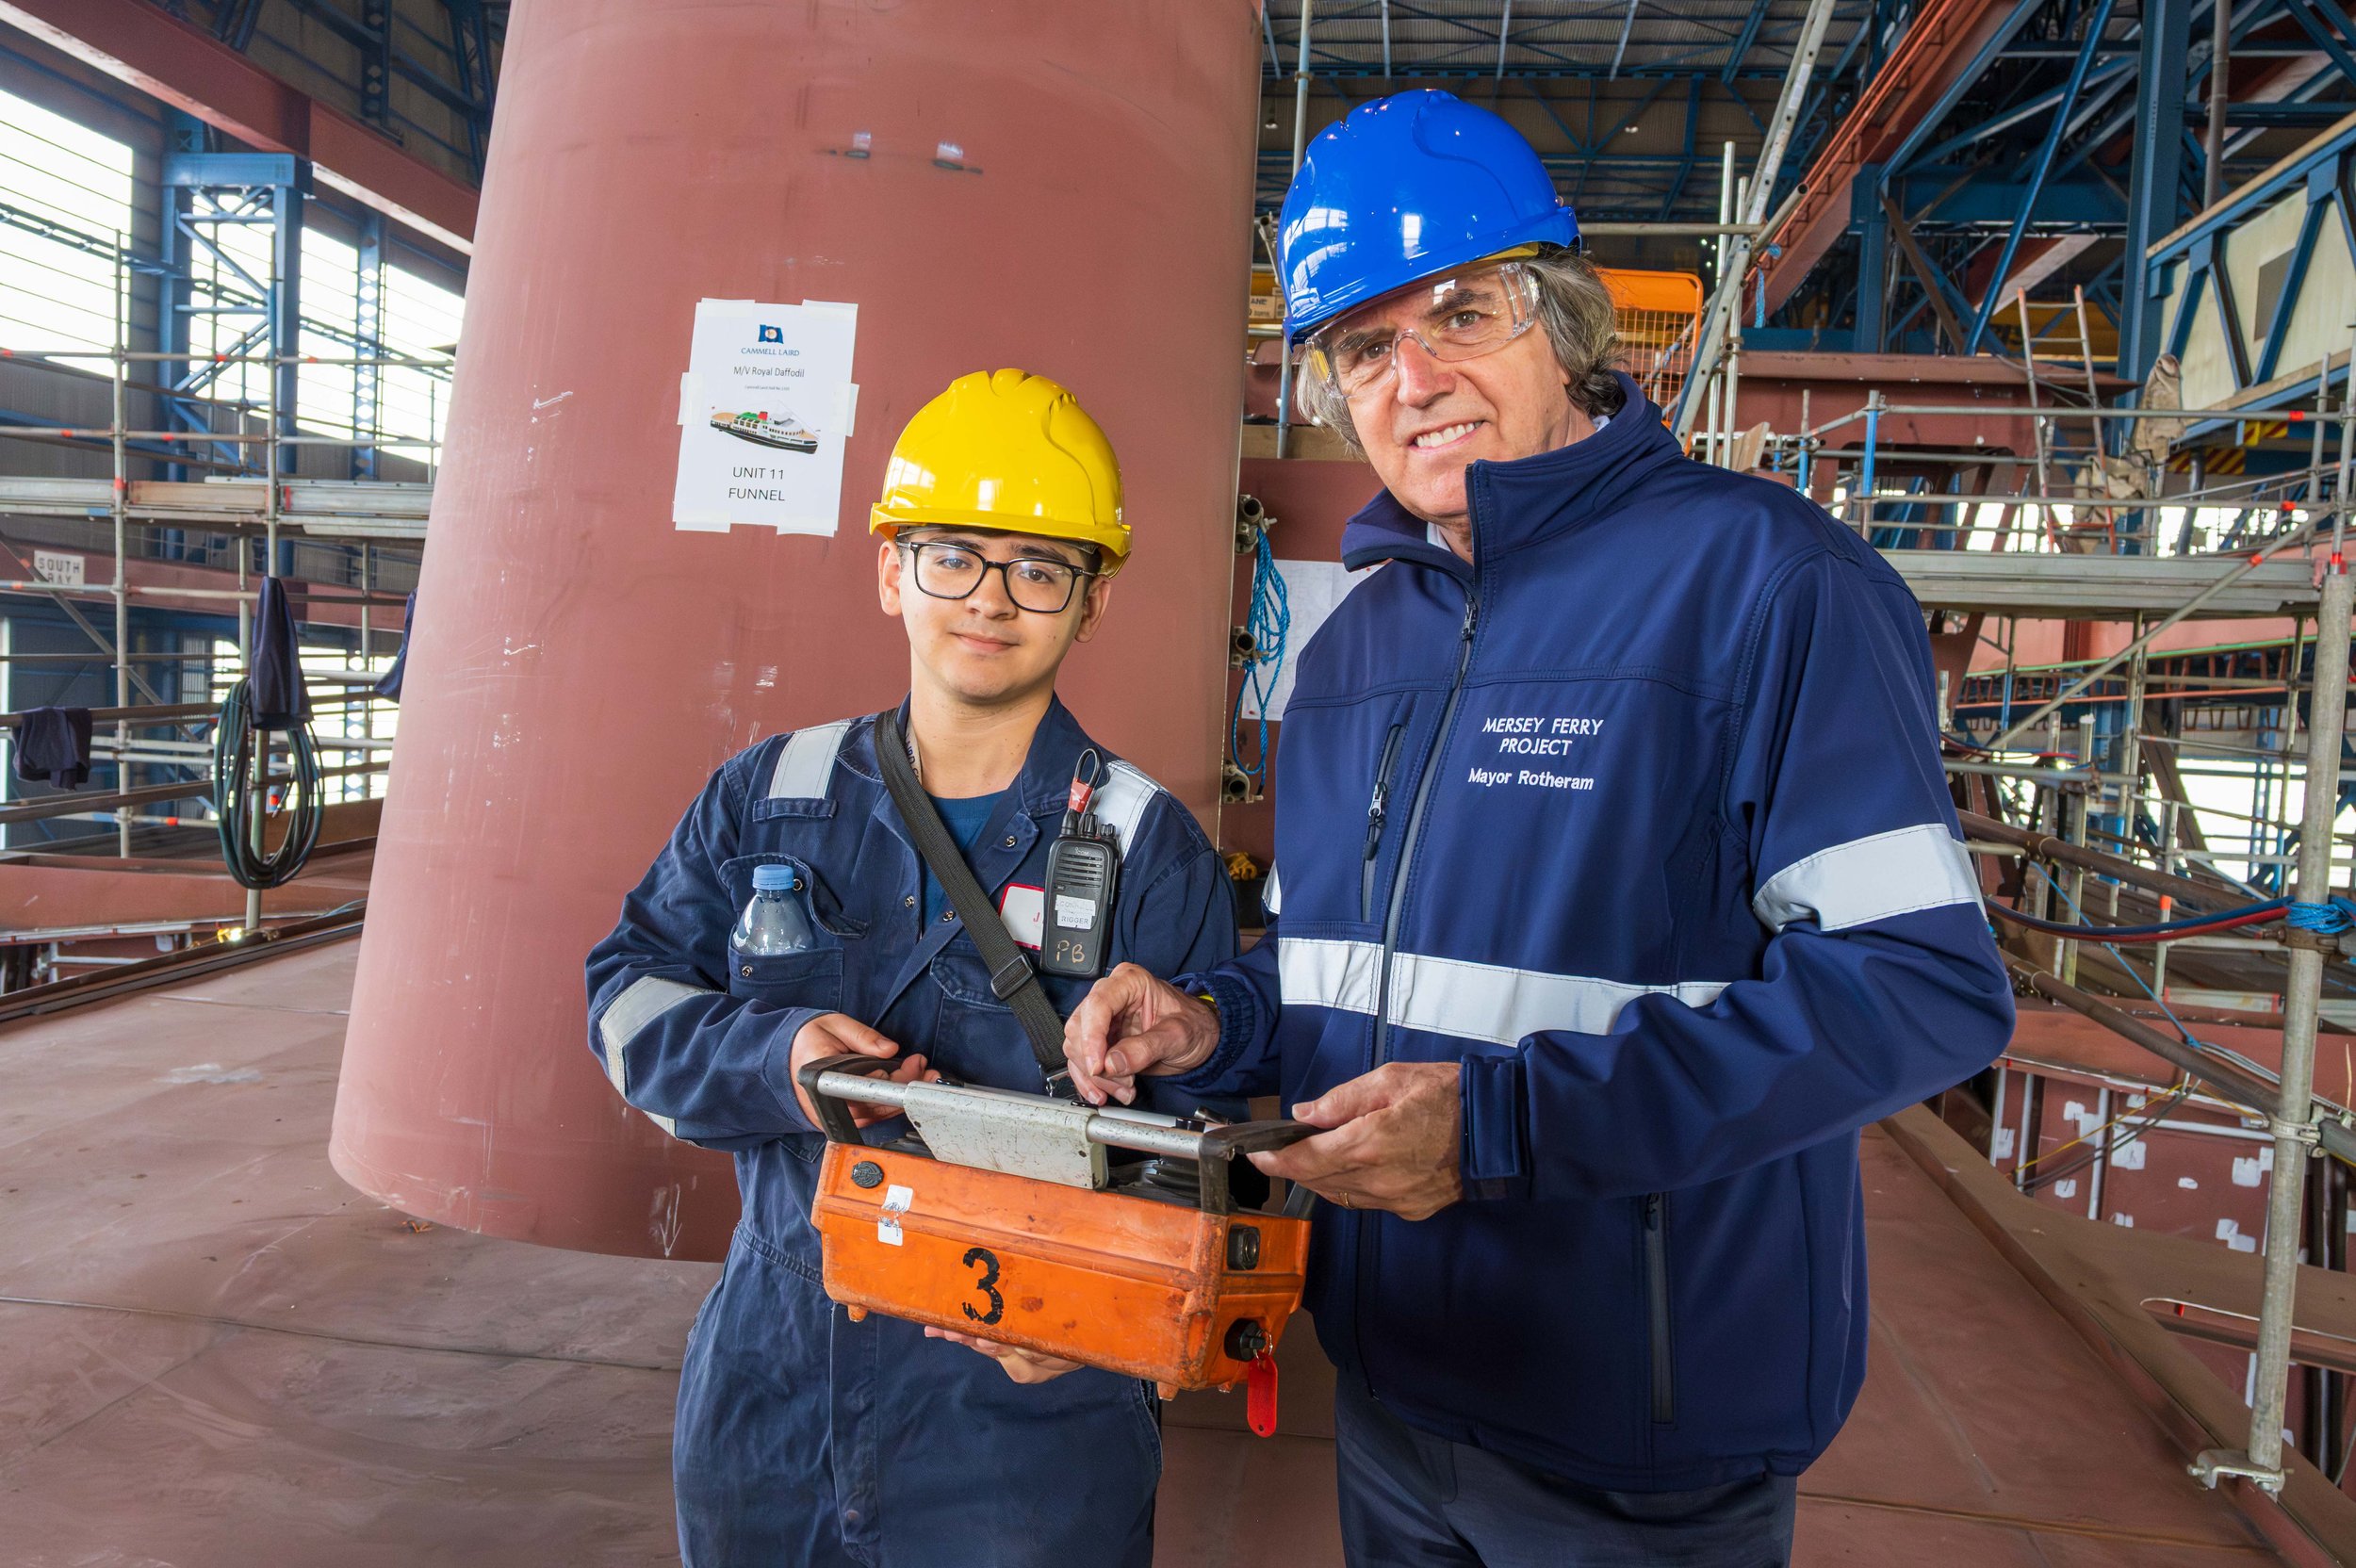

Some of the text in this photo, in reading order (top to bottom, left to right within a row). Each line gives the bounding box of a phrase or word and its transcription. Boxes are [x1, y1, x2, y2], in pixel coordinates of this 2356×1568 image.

[741, 348, 777, 356] CAMMELL
[733, 366, 805, 378] M/V Royal Daffodil
[732, 466, 784, 480] UNIT 11
[728, 487, 785, 501] FUNNEL
[39, 557, 80, 573] SOUTH
[1482, 717, 1604, 735] MERSEY FERRY
[1498, 738, 1573, 756] PROJECT
[1467, 767, 1595, 790] Mayor Rotheram
[1061, 915, 1089, 924] RIGGER
[962, 1247, 1004, 1325] 3
